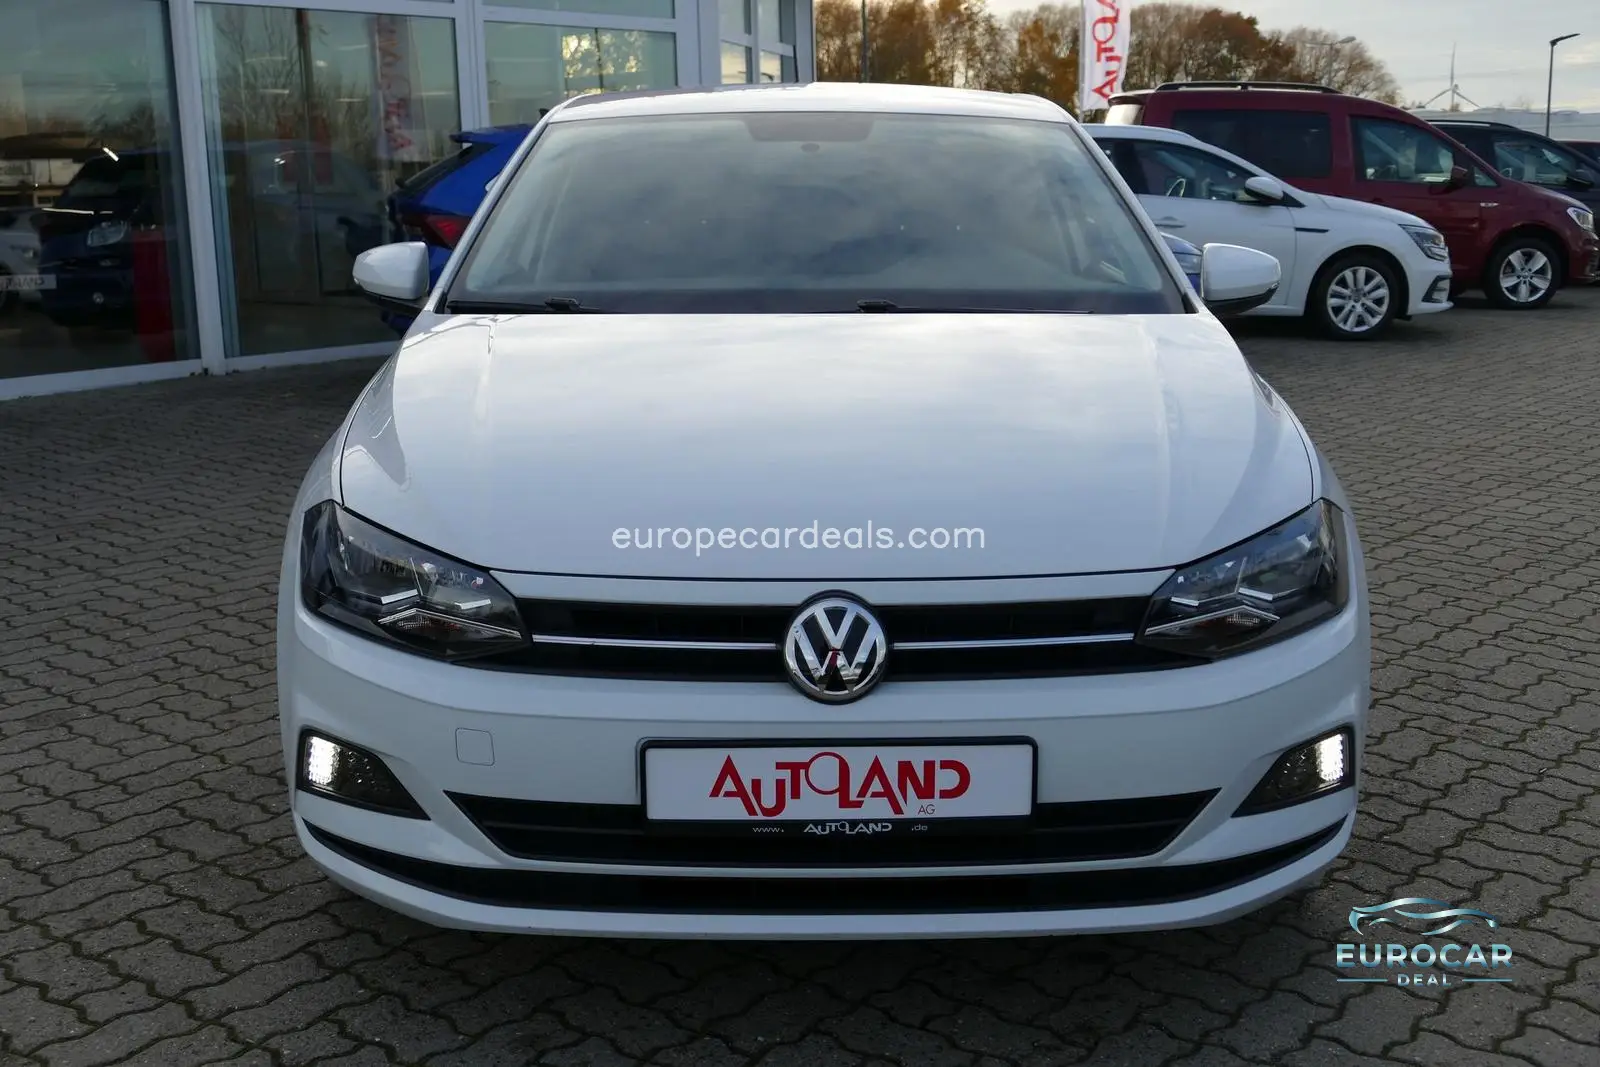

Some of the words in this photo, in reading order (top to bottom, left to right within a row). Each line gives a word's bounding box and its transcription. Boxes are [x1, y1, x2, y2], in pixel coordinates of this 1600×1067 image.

[785, 598, 887, 701] VW
[709, 751, 971, 818] AUTOLAND
[803, 820, 893, 836] AUTOLAND
[917, 804, 936, 815] AG
